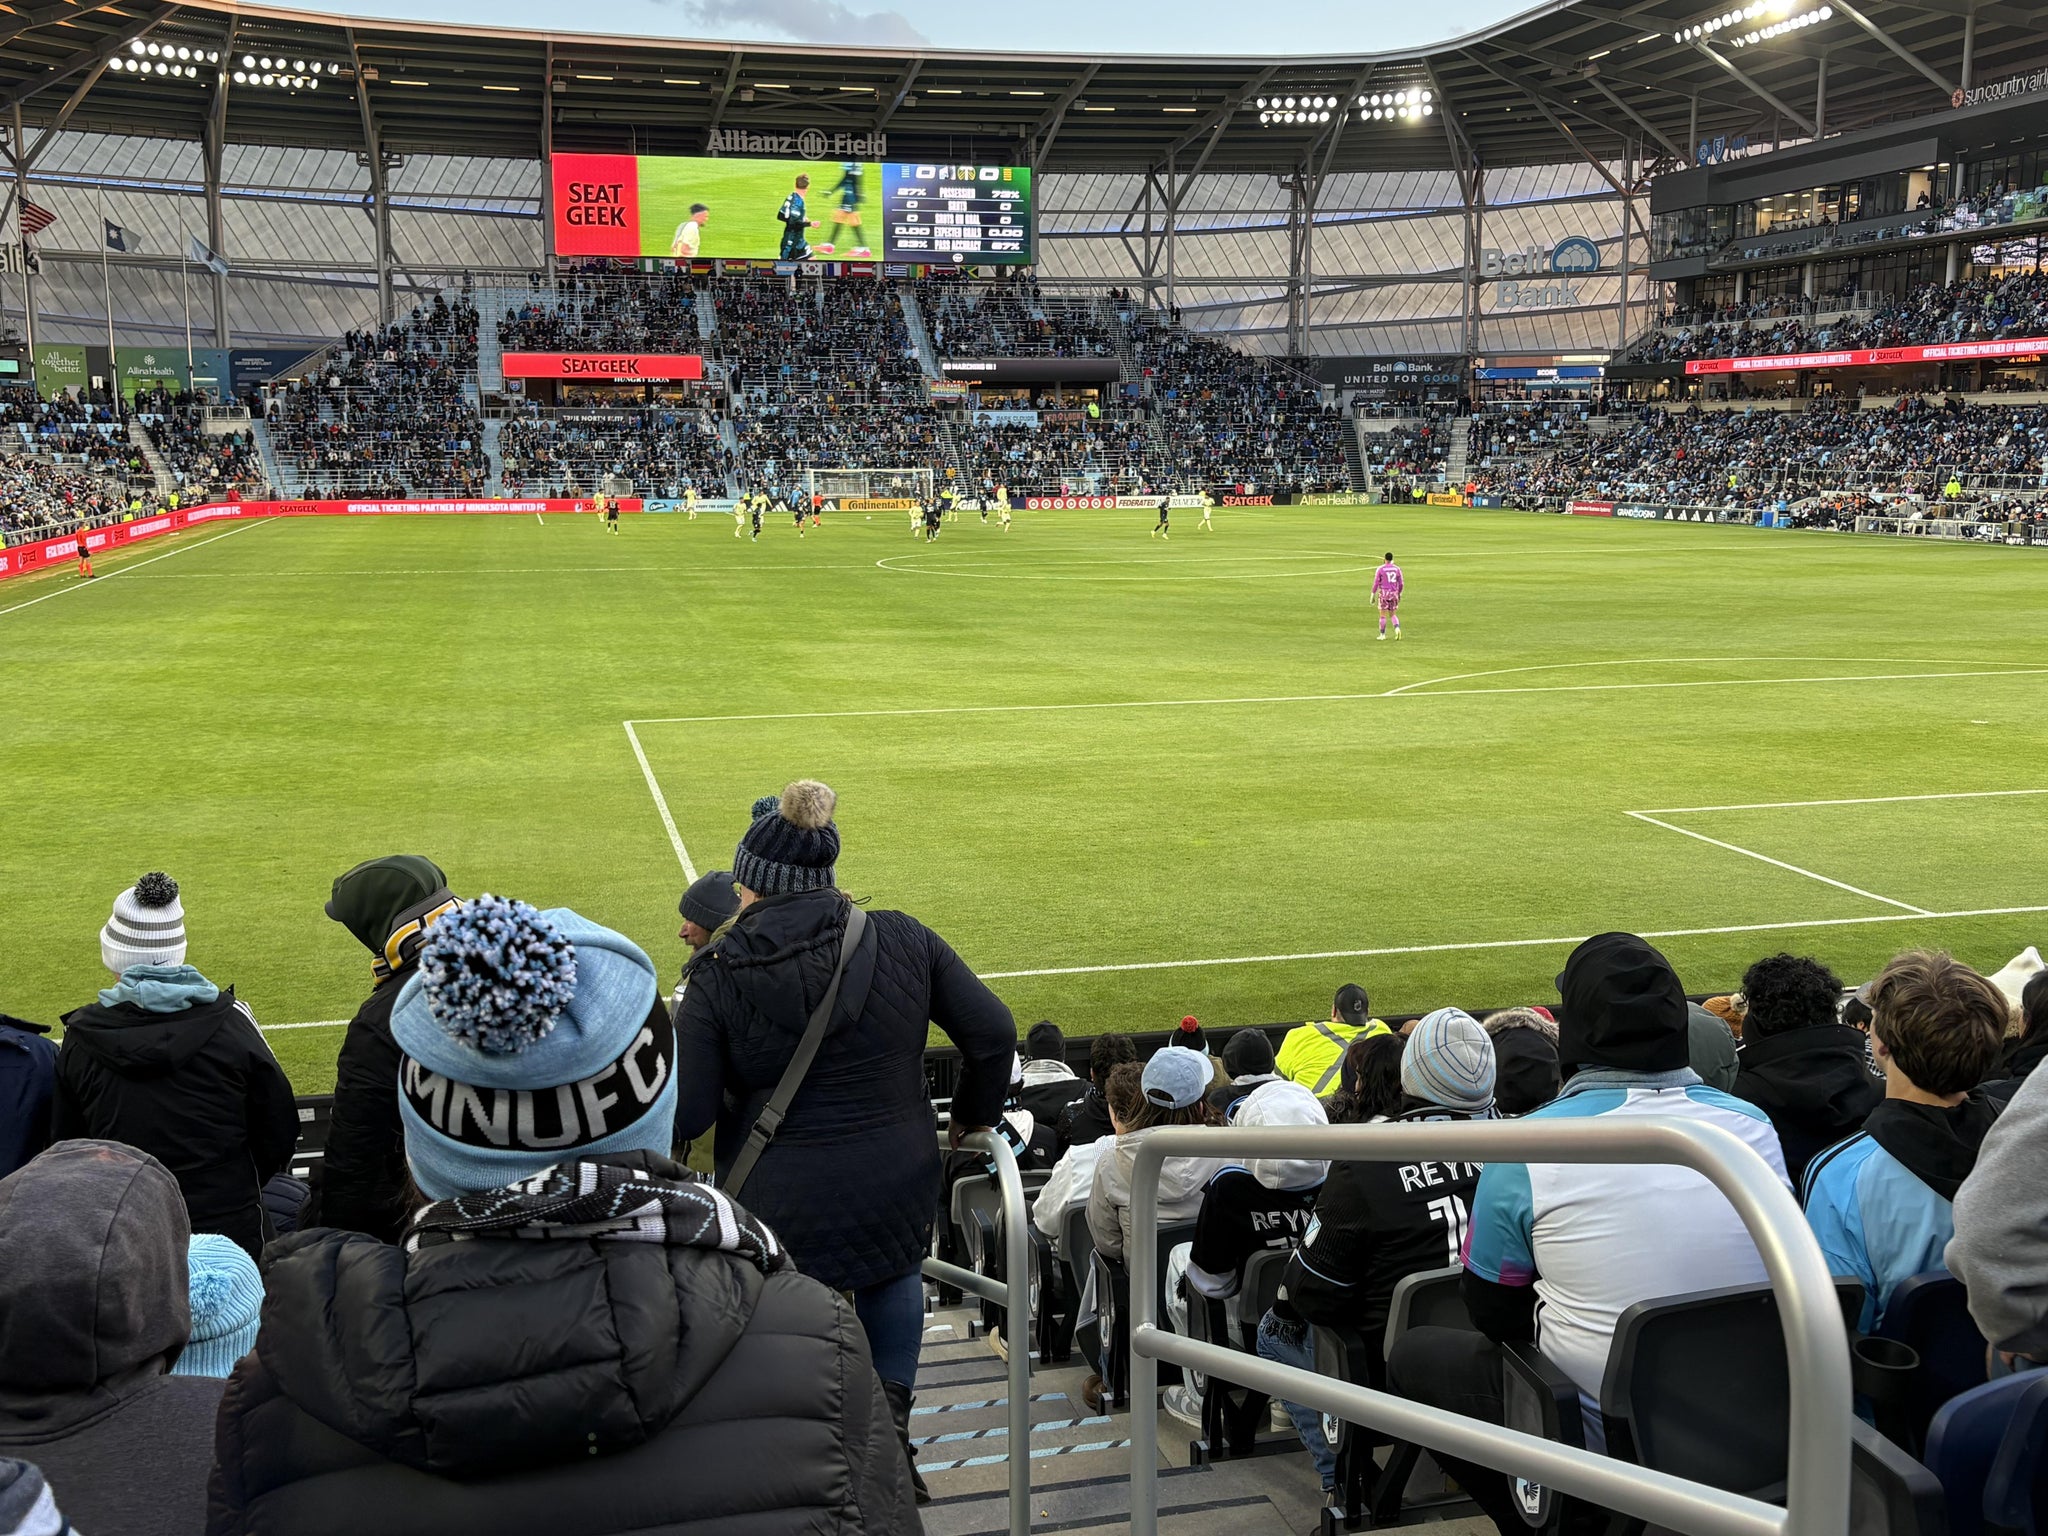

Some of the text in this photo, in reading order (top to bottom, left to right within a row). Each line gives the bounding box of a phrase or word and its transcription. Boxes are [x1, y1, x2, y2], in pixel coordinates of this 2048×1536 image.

[1965, 87, 1984, 103] sun
[1985, 76, 2029, 99] country
[707, 129, 887, 156] Allianz Field
[916, 166, 999, 180] 0 0
[568, 182, 624, 204] SEAT
[566, 206, 627, 227] GEEK
[1480, 246, 1544, 276] Bell
[1497, 278, 1580, 308] Bank
[41, 357, 80, 368] together
[47, 351, 60, 361] All
[562, 358, 640, 374] SEATGEEK
[1373, 363, 1433, 372] Bell Bank
[1344, 374, 1460, 384] UNITED FOR GOOD
[466, 503, 508, 512] MINNESOTA
[509, 503, 536, 511] UNITED
[537, 503, 546, 511] FC
[848, 500, 898, 510] Continental
[1223, 496, 1273, 507] SEATGEEK
[1386, 572, 1397, 582] 12
[405, 1027, 666, 1148] MNUFC
